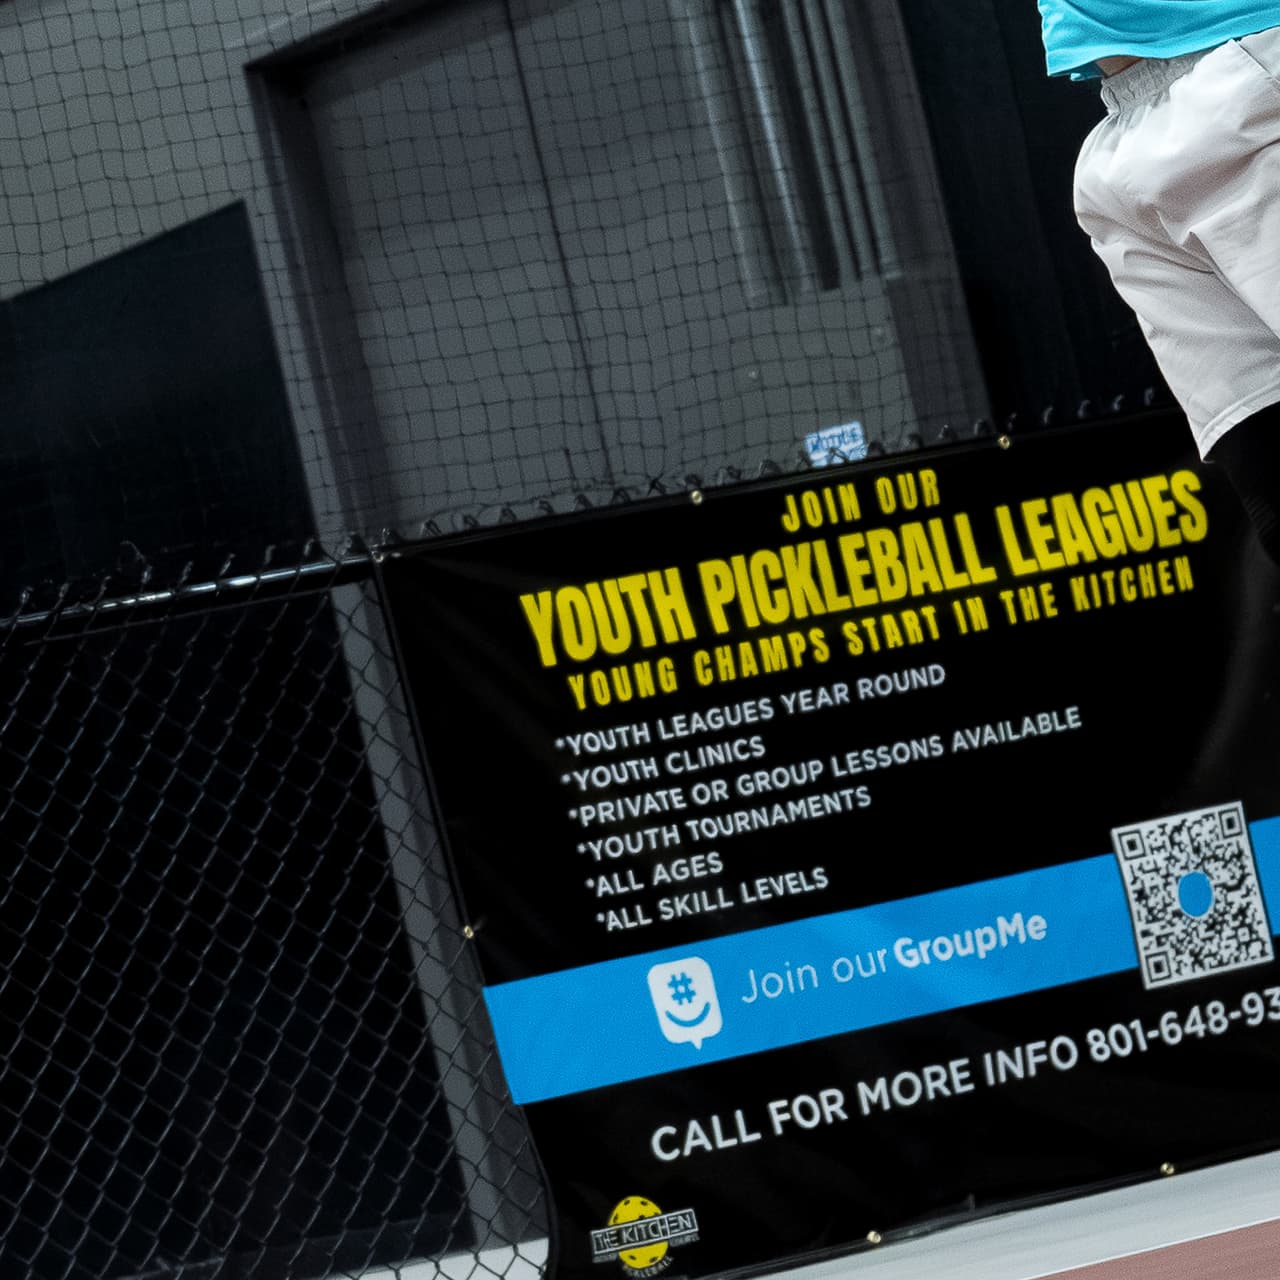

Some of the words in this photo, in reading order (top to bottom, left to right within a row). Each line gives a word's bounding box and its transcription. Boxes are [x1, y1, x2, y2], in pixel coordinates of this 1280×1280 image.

[781, 482, 861, 533] JOIN
[875, 468, 941, 515] OUR
[520, 567, 696, 667] YOUTH
[698, 513, 997, 634] PICKLEBALL
[995, 470, 1208, 577] LEAGUES
[567, 656, 678, 710] YOUNG
[693, 627, 830, 686] CHAMPS
[843, 605, 940, 656] START
[952, 596, 989, 635] IN
[1000, 582, 1058, 625] THE
[1070, 555, 1195, 612] KITCHEN
[657, 698, 774, 740] LEAGUES
[781, 682, 850, 714] YEAR
[857, 664, 946, 699] ROUND
[665, 736, 766, 774] CLINICS
[691, 779, 729, 805] OR
[736, 759, 824, 795] GROUP
[831, 735, 944, 777] LESSONS
[951, 706, 1082, 752] AVAILABLE
[685, 785, 872, 841] TOURNAMENTS
[652, 851, 724, 886] AGES
[658, 887, 734, 920] SKILL
[740, 866, 829, 904] LEVELS
[742, 961, 818, 1003] Join
[832, 948, 888, 983] our
[893, 911, 1048, 969] GroupMe
[651, 1109, 761, 1162] CALL
[768, 1089, 848, 1136] FOR
[856, 1057, 975, 1115] MORE
[984, 1034, 1079, 1087] INFO
[593, 1229, 619, 1248] THE
[622, 1214, 693, 1244] KITCHEN
